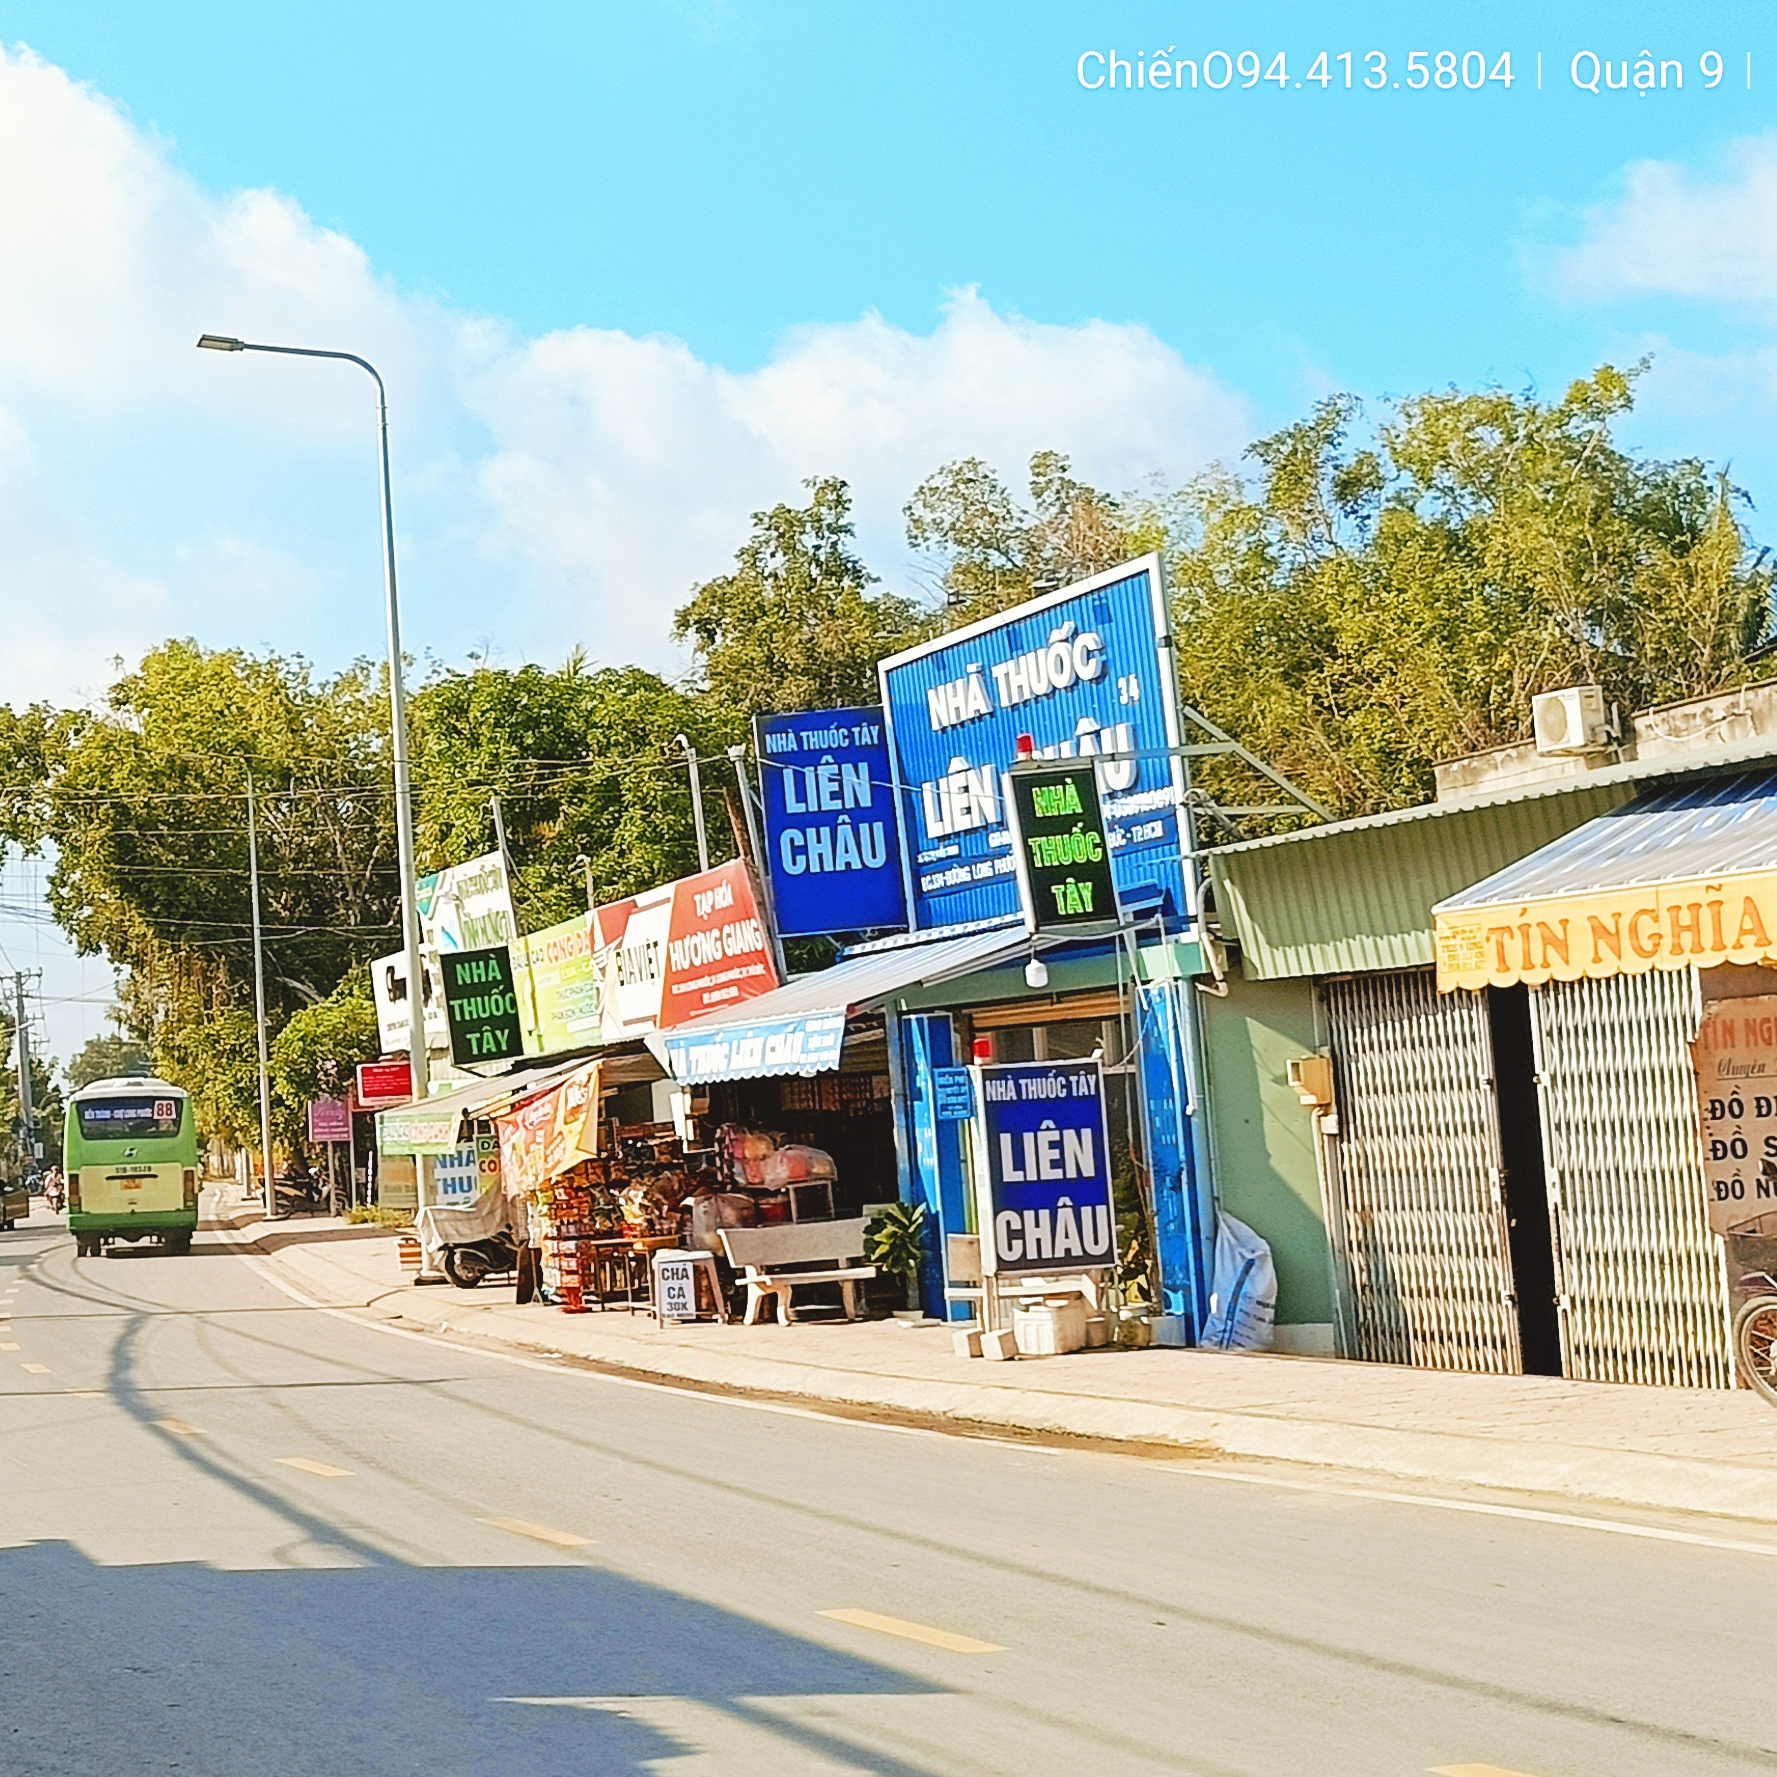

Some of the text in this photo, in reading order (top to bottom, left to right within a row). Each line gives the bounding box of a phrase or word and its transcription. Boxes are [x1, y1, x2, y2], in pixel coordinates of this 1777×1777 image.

[926, 620, 1105, 731] NHÀ THUỐC
[765, 722, 880, 754] NHÀ THUỐC TÂY
[783, 755, 873, 814] LIÊN
[921, 756, 1001, 839] LIÊN
[1032, 778, 1083, 817] NHÀ
[780, 815, 887, 875] CHÂU
[1028, 822, 1103, 868] THUỐC
[693, 879, 734, 920] TẠP HÓA
[1051, 877, 1093, 915] TÂY
[669, 918, 763, 973] HƯƠNG GIANG
[1486, 908, 1569, 973] TÍN
[1587, 883, 1772, 964] NGHĨA
[455, 953, 502, 985] NHÀ
[449, 985, 517, 1021] THUỐC
[466, 1025, 509, 1055] TÂY
[1699, 1012, 1736, 1050] TÍN
[985, 1074, 1017, 1101] NHÀ
[1018, 1070, 1066, 1100] THUỐC
[1069, 1074, 1097, 1097] TÂY
[1717, 1058, 1766, 1079] Chuyên
[156, 1102, 173, 1117] 88
[1709, 1084, 1744, 1121] ĐỒ
[999, 1119, 1096, 1183] LIÊN
[1710, 1125, 1748, 1161] ĐỒ
[1716, 1168, 1745, 1201] ĐỒ
[995, 1196, 1110, 1263] CHÂU
